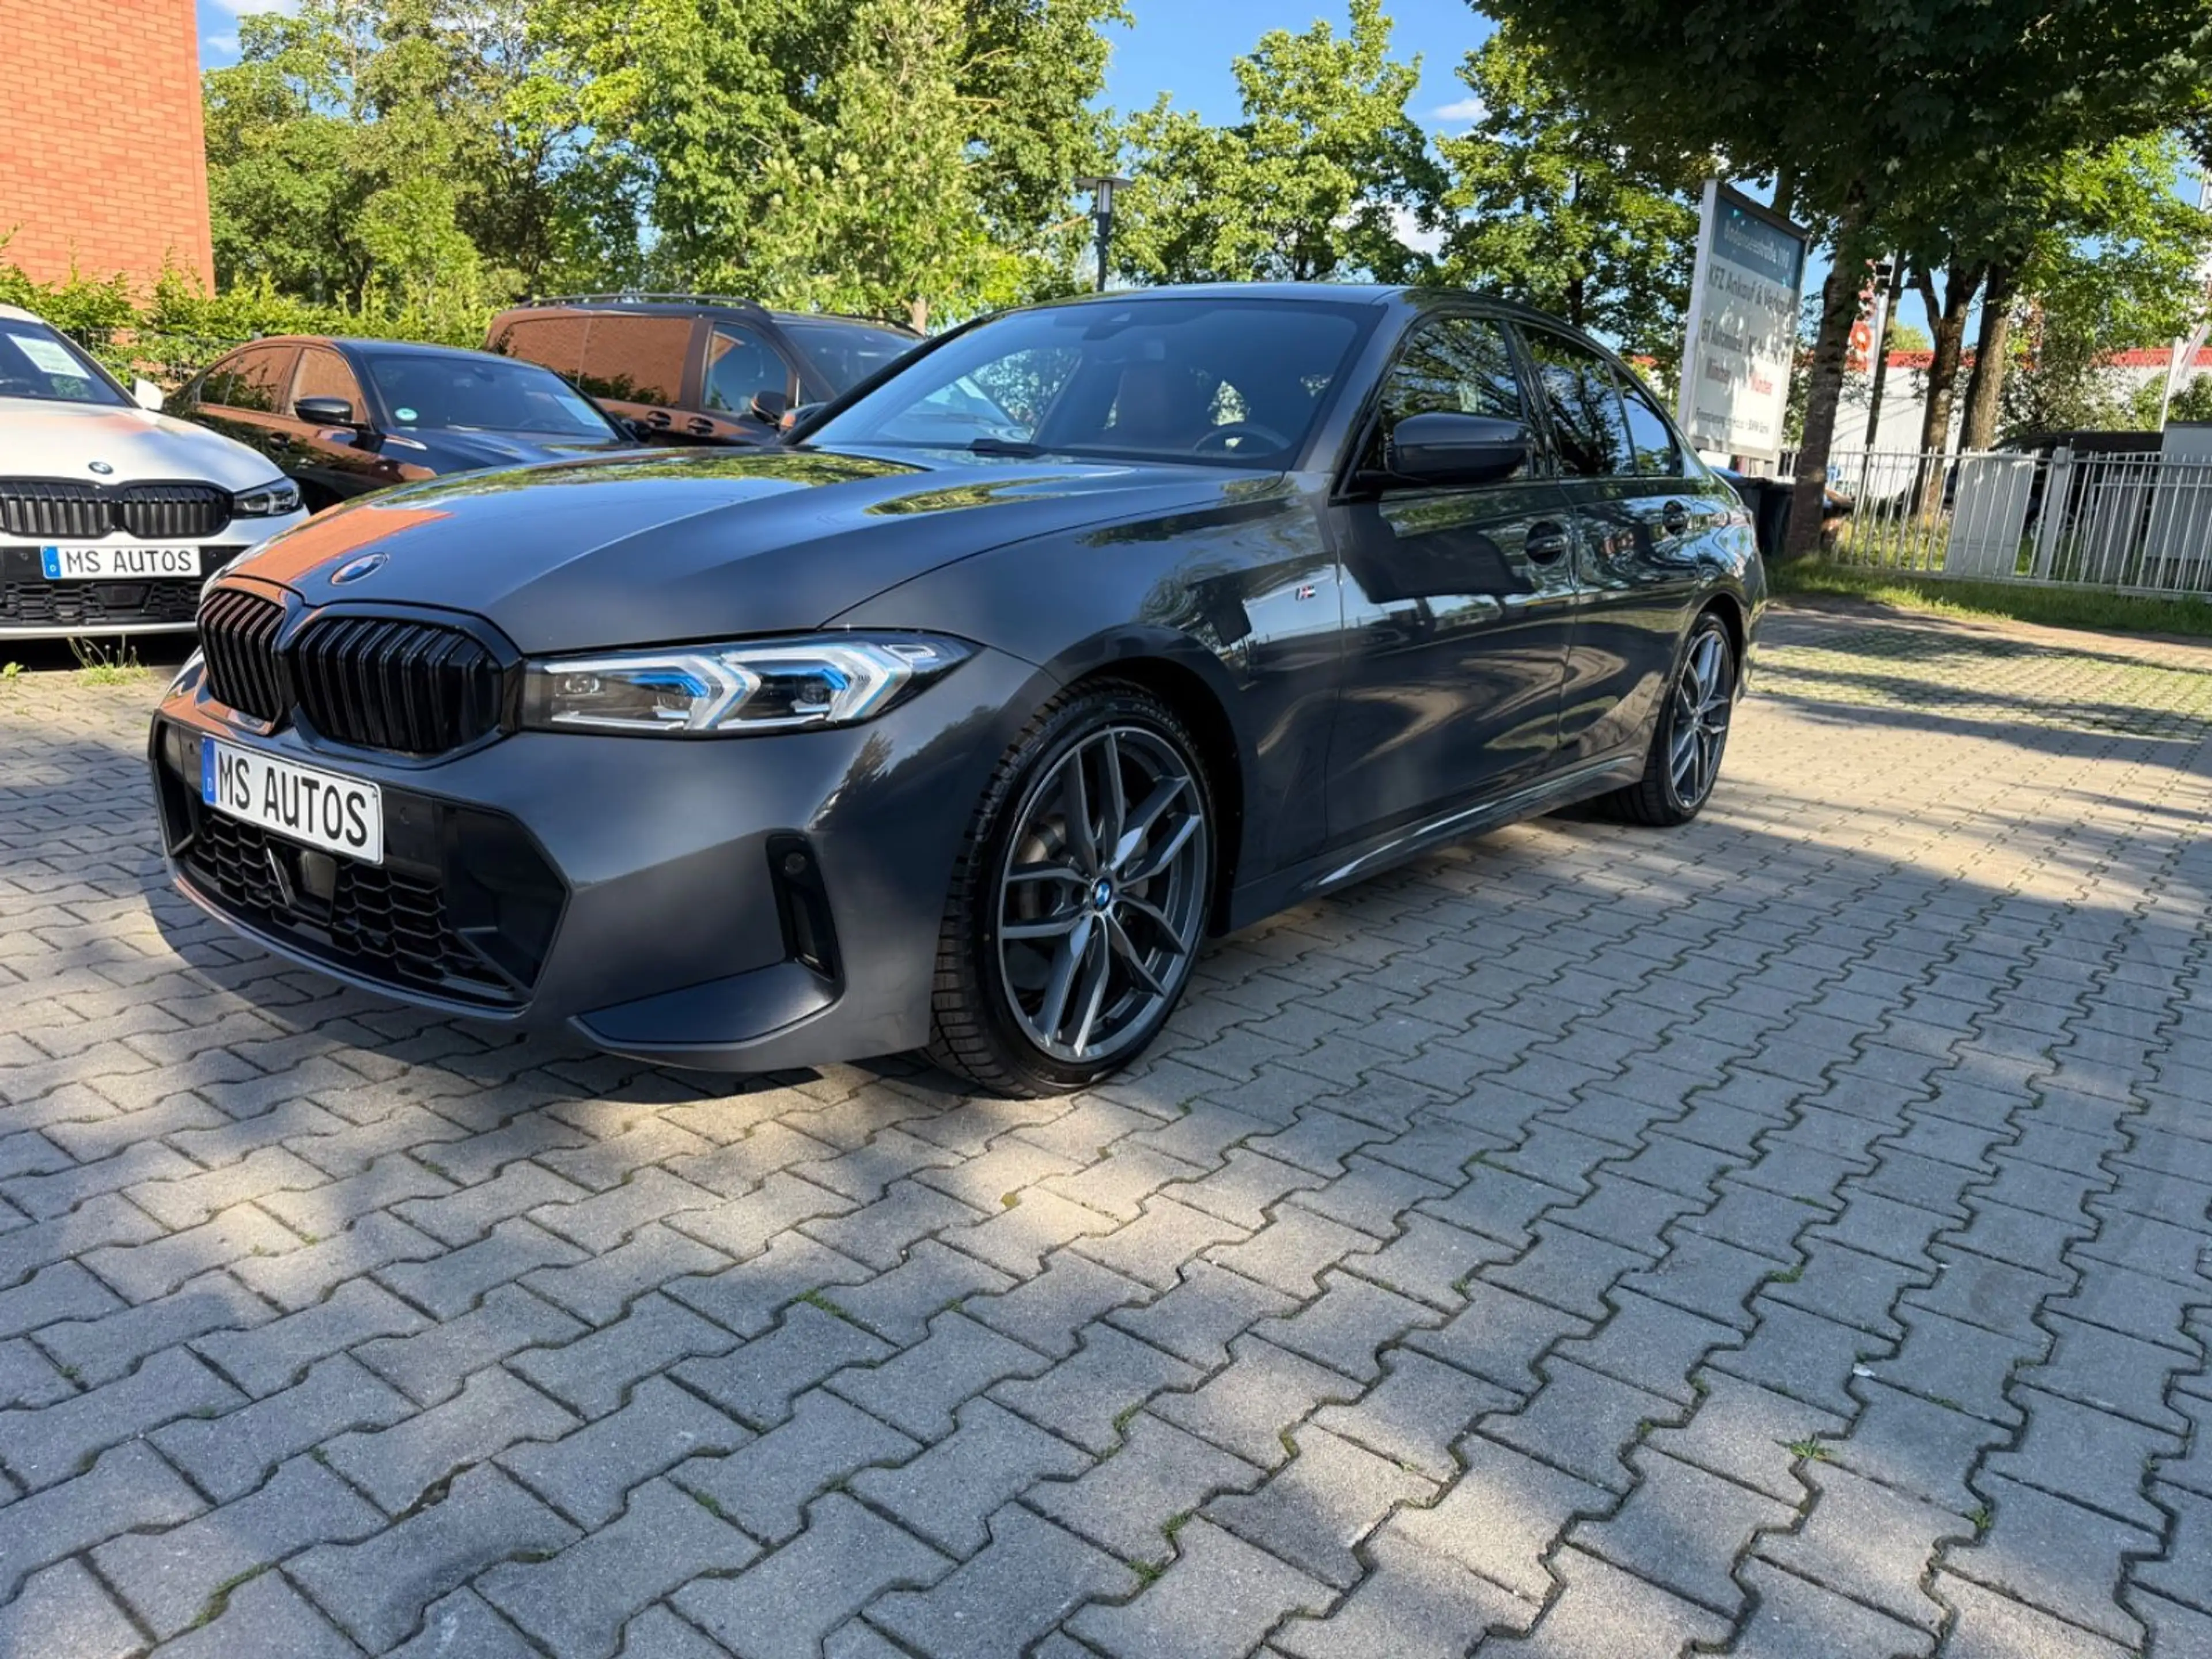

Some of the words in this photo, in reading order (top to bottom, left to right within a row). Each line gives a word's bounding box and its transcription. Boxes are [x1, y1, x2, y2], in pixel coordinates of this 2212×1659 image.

[66, 551, 101, 573] MS
[113, 550, 192, 573] AUTOS
[219, 751, 250, 810] MS
[263, 766, 368, 847] AUTOS
